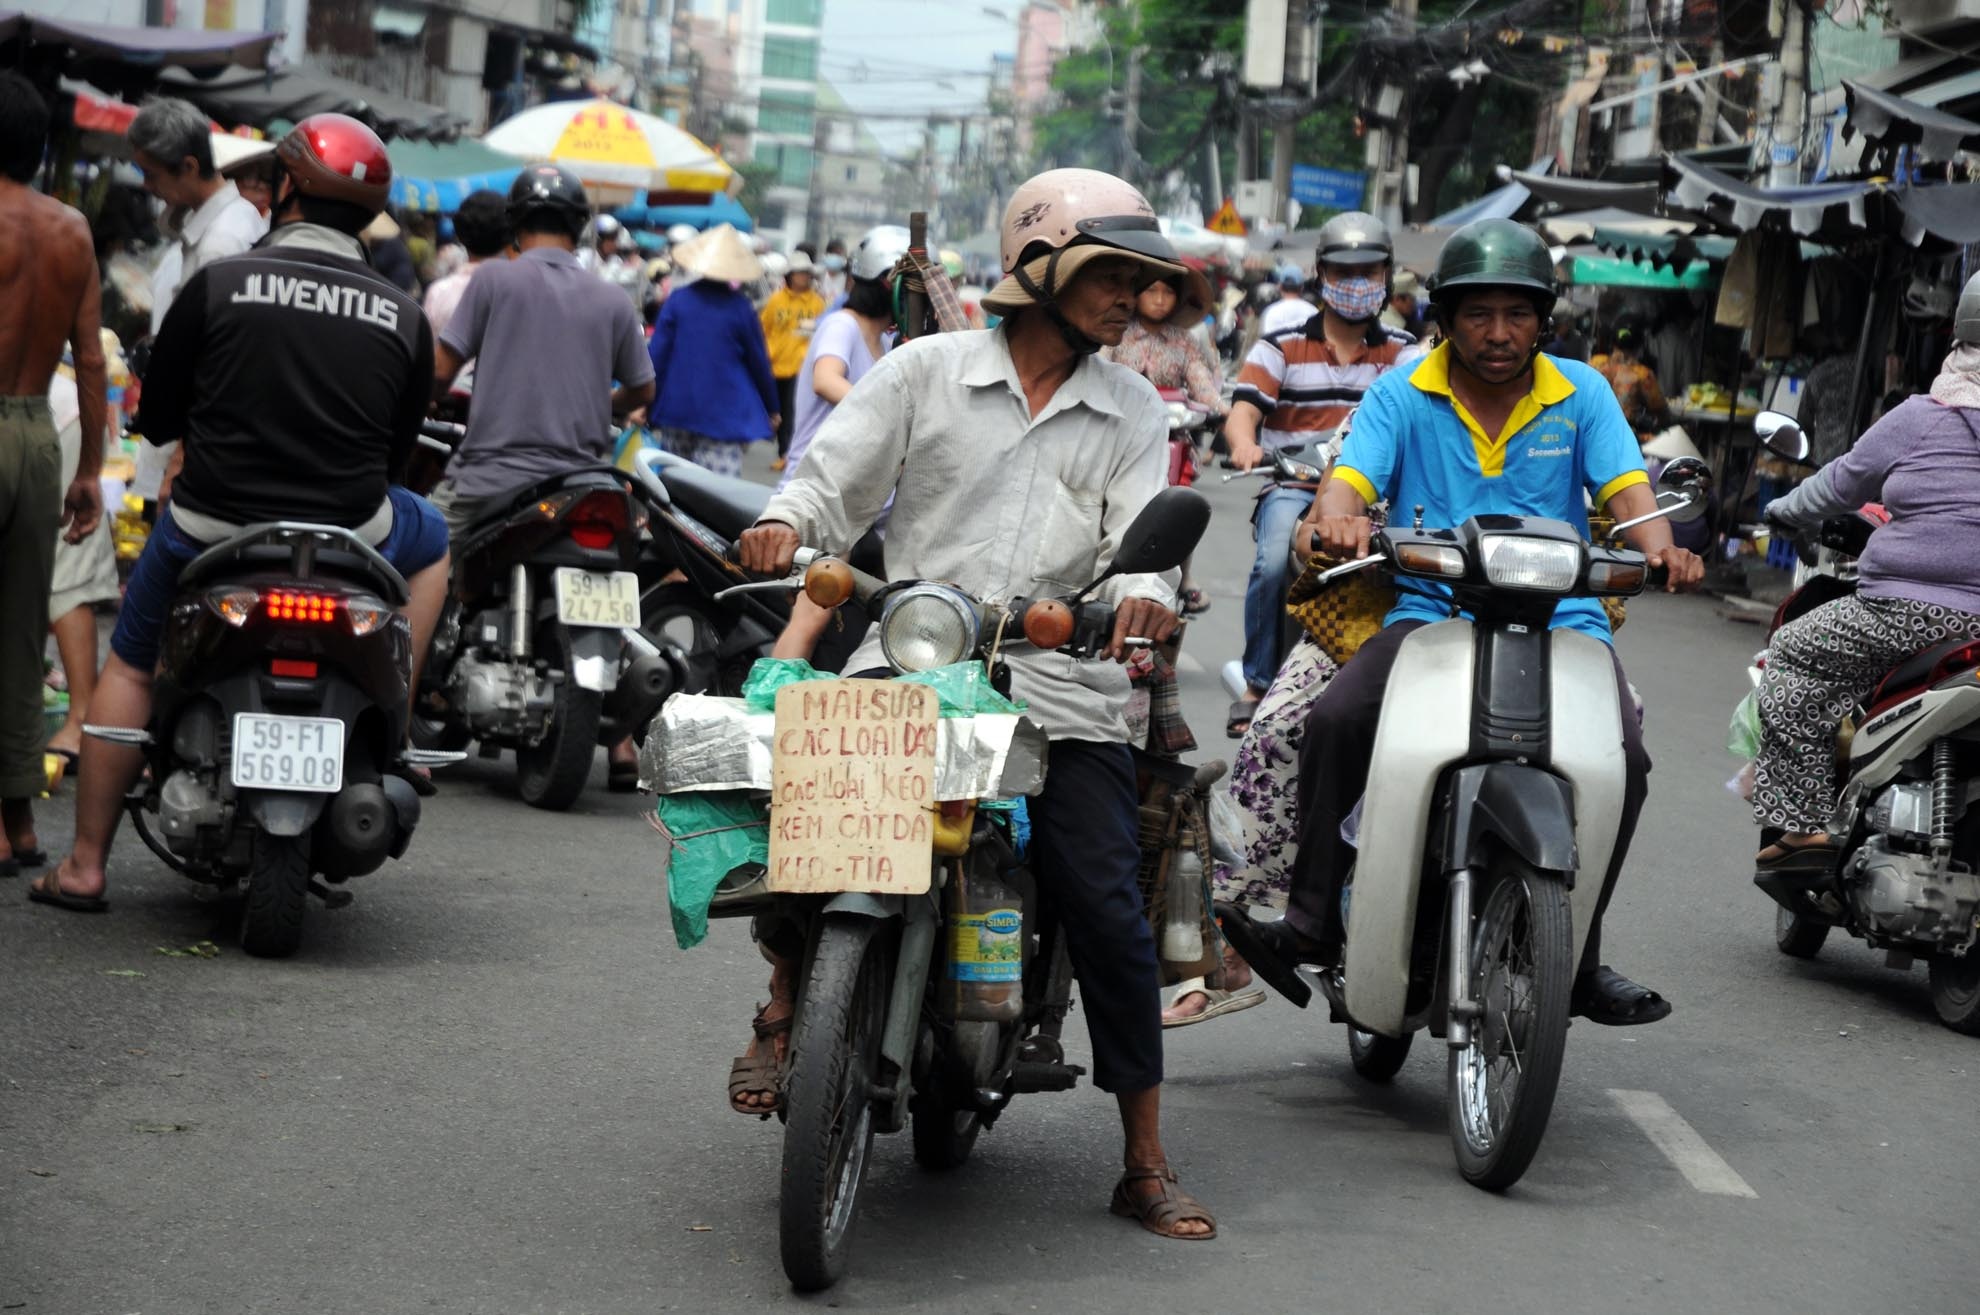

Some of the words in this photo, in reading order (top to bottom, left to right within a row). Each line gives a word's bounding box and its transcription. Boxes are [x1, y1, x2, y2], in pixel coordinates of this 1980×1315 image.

[231, 273, 399, 332] JUVENTUS
[564, 599, 634, 624] 247.58
[252, 721, 325, 753] 59-F1
[241, 753, 336, 786] 569.08
